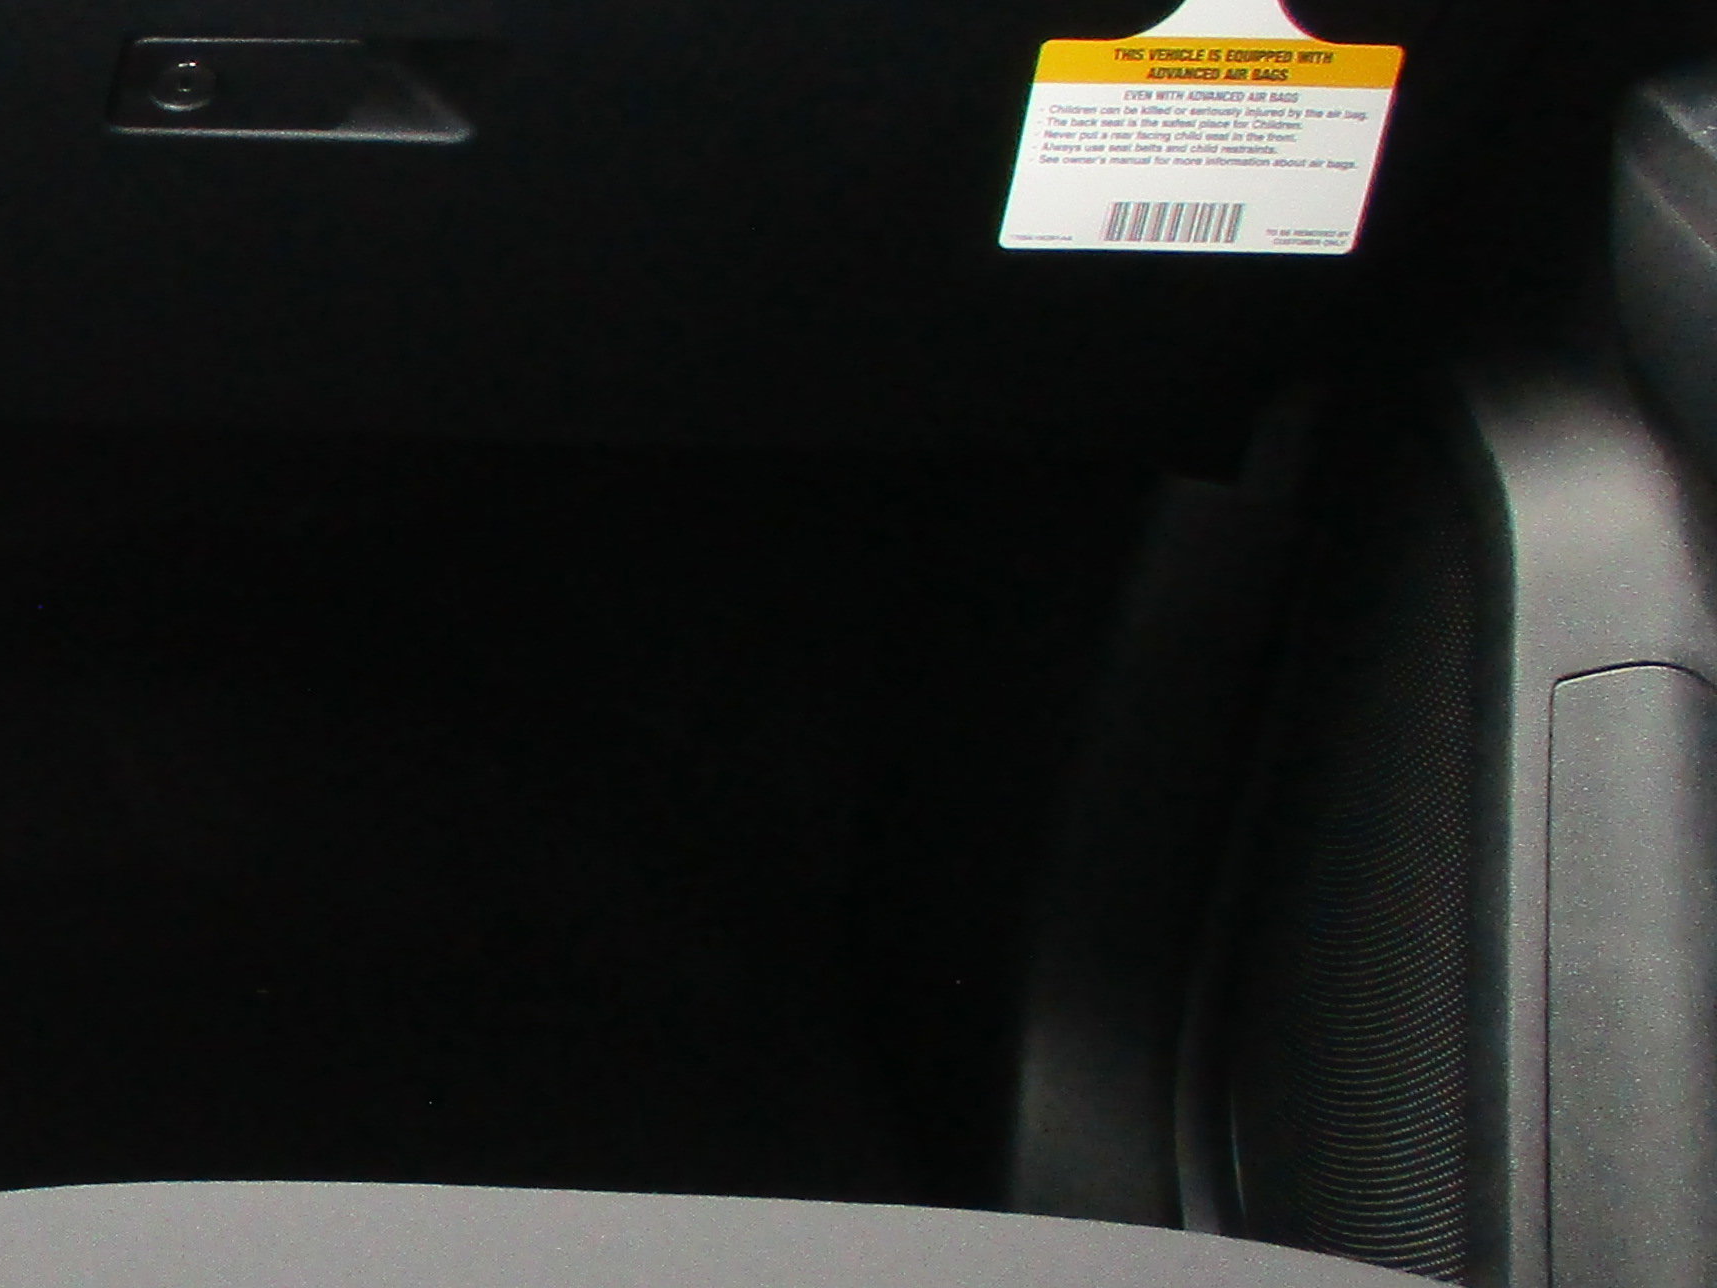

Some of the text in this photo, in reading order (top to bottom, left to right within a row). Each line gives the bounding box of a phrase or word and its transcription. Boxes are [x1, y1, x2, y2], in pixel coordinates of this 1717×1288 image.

[1114, 48, 1334, 64] THIS VEHICLE IS EQUIPPED WITH
[1146, 67, 1290, 81] ADVANCED AIR BAGS
[1122, 90, 1154, 101] EVEN
[1155, 90, 1185, 101] WITH
[1187, 91, 1246, 102] ADVANCED
[1049, 104, 1097, 114] Children
[1123, 106, 1138, 115] be
[1047, 118, 1067, 127] The
[1070, 118, 1098, 127] back
[1043, 130, 1076, 139] Never
